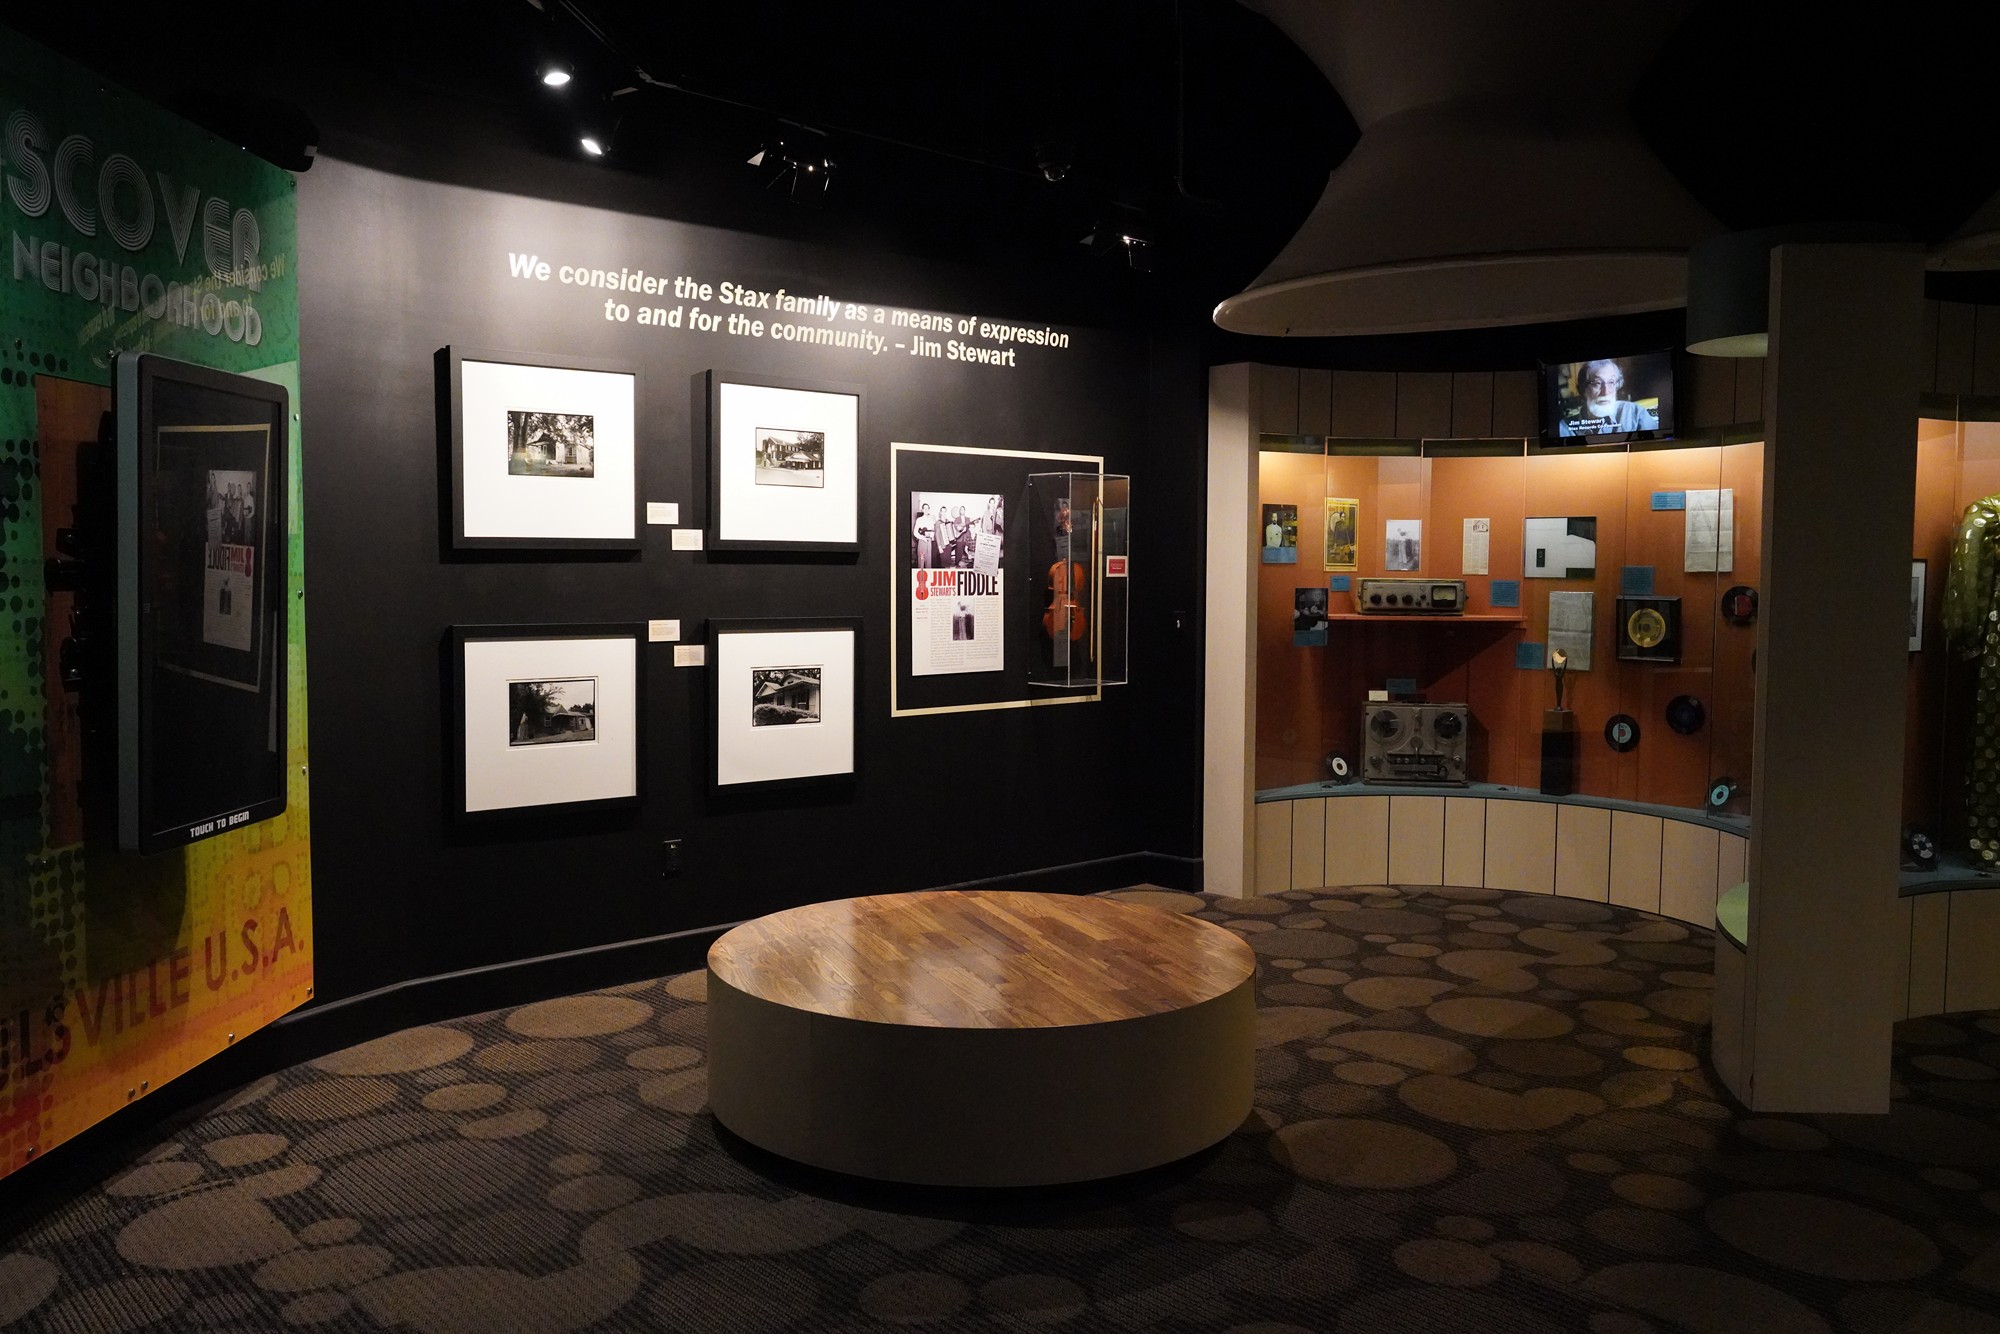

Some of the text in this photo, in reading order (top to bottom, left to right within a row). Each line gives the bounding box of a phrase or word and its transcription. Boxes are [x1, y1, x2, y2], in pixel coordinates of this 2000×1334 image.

[13, 229, 262, 345] NEIGHBORHOOD
[508, 252, 1070, 348] We consider the Stax family as a means of expression
[604, 298, 630, 322] to
[636, 306, 683, 328] and
[689, 307, 722, 332] for
[727, 313, 764, 337] the
[770, 322, 888, 355] community.
[910, 335, 942, 358] Jim
[946, 339, 1016, 367] Stewart
[930, 571, 999, 596] JIM FIDDLE
[930, 587, 956, 597] STEWART'S
[190, 810, 250, 838] TOUCH TO BEGIN
[0, 906, 305, 1088] LSVILLE U.S.A.
